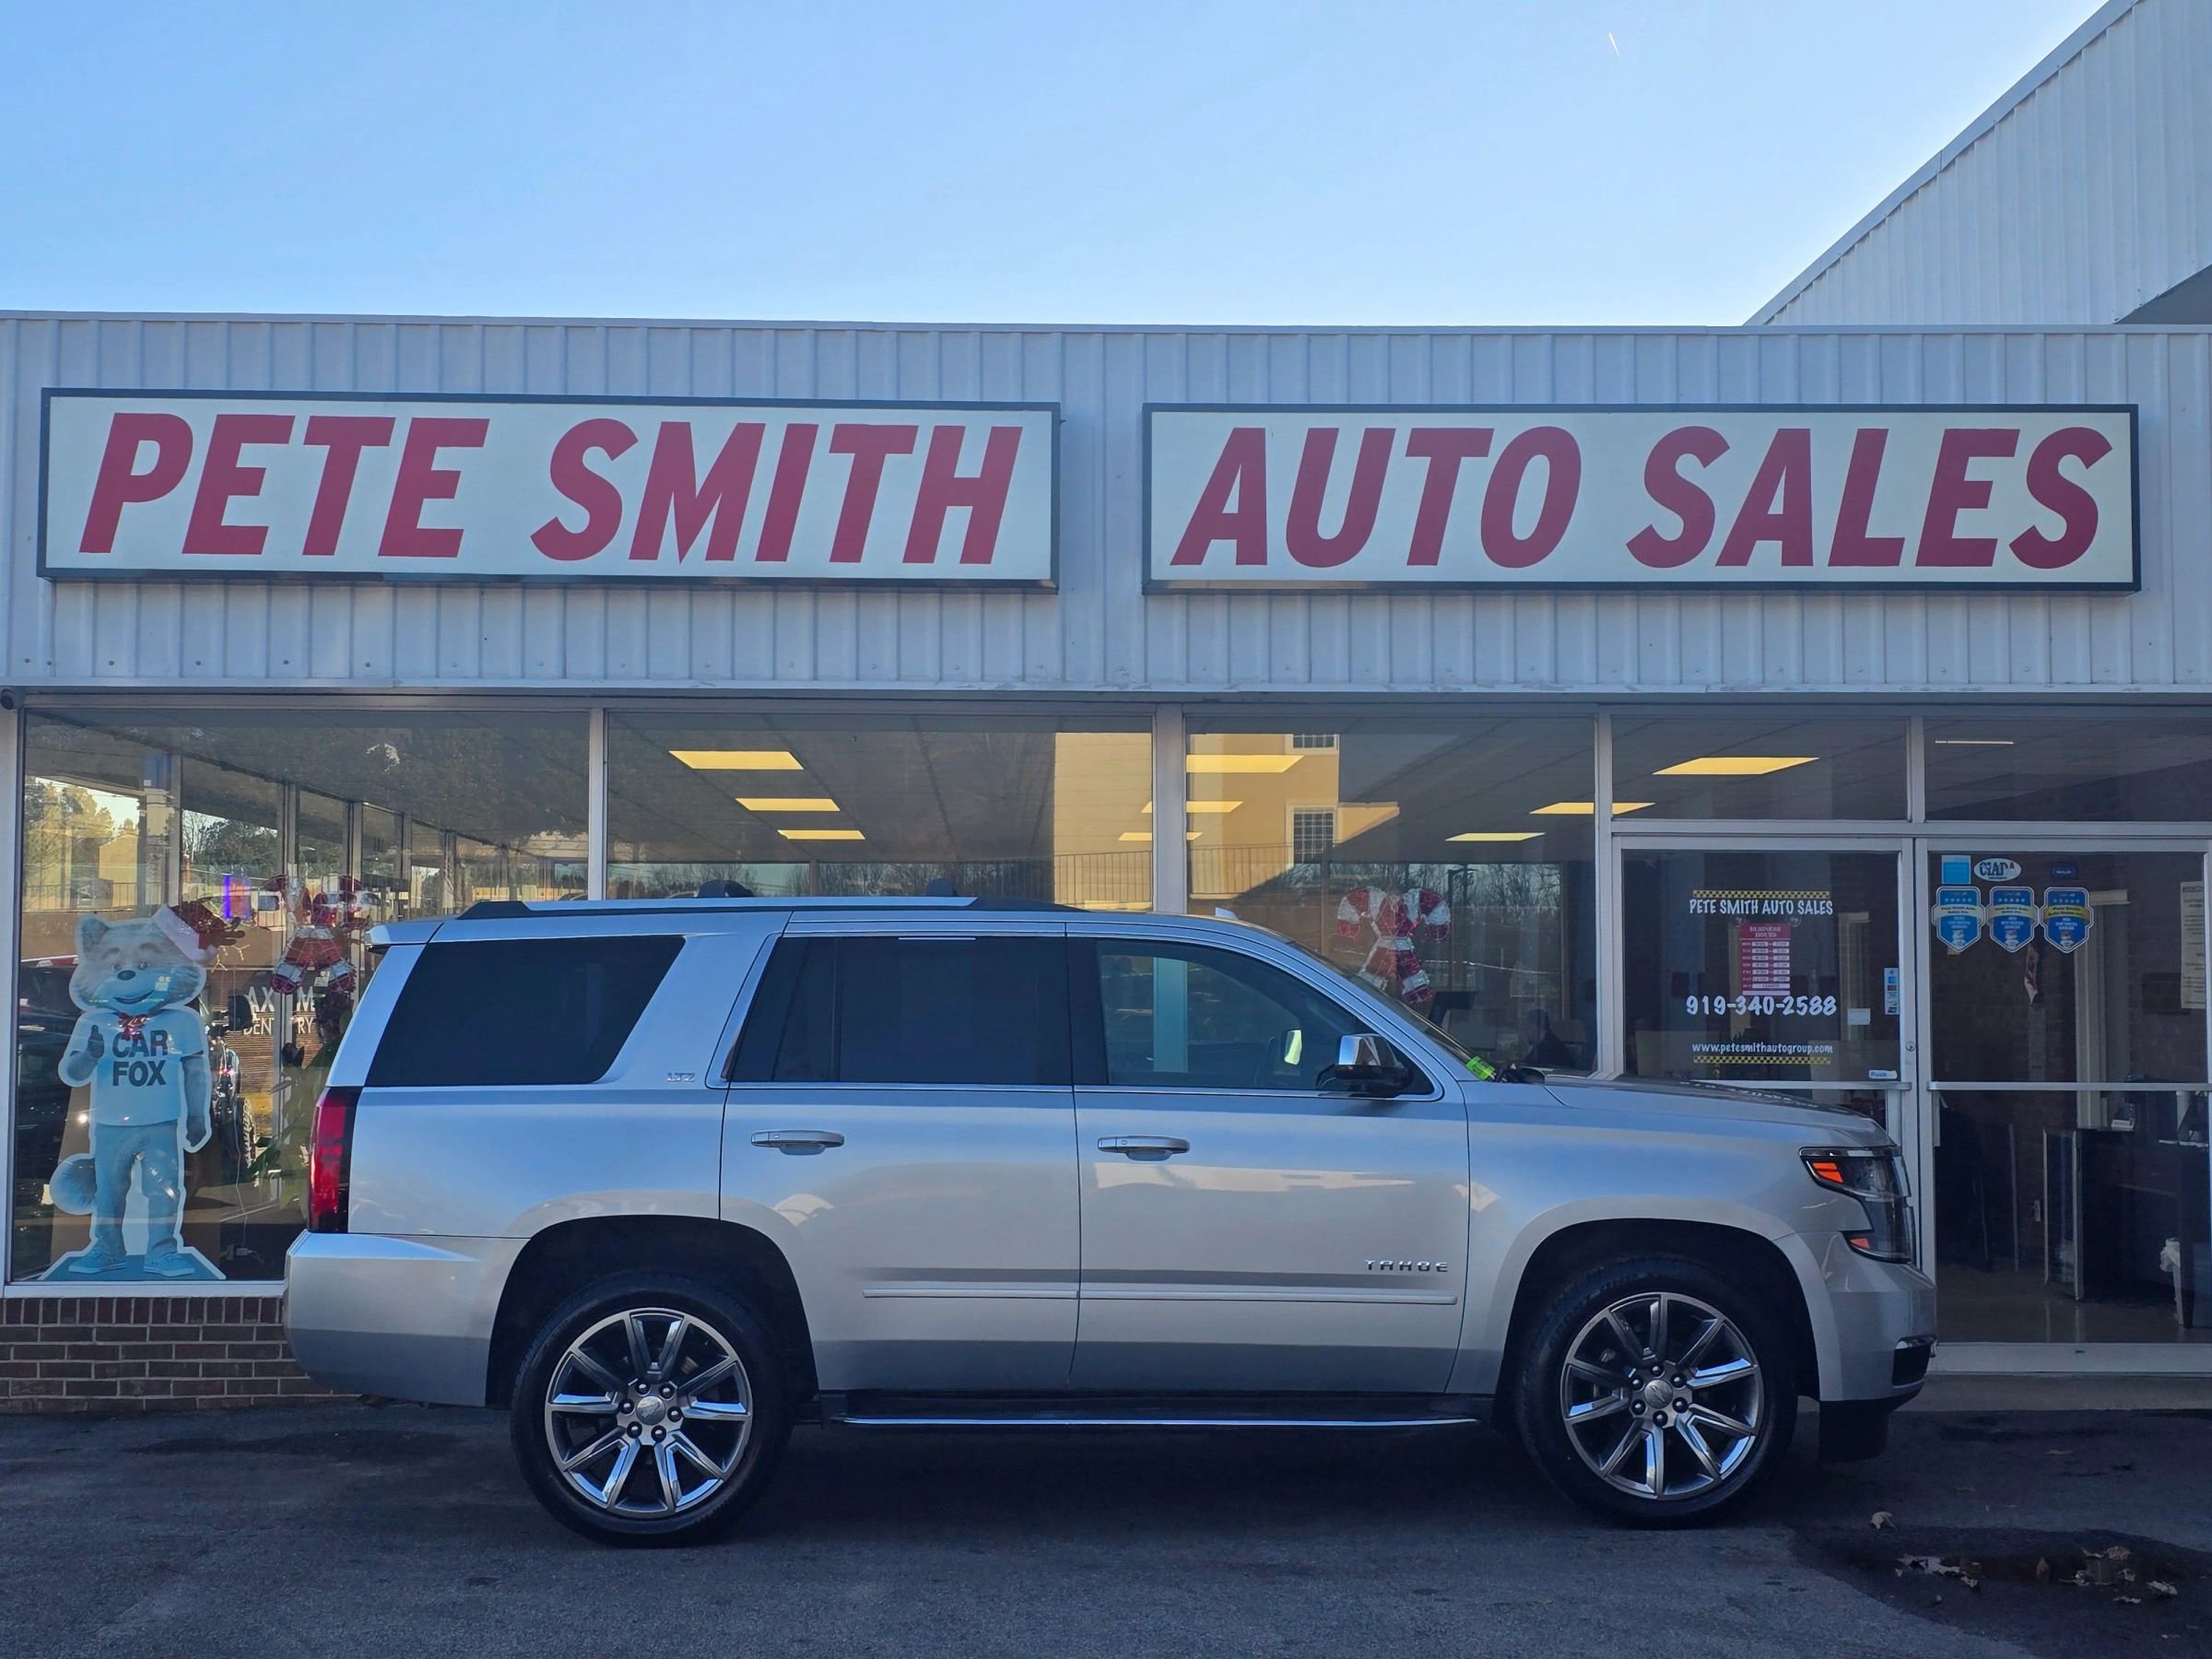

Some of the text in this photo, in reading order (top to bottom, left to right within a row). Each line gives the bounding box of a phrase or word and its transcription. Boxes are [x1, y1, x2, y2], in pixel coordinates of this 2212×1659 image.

[78, 413, 1023, 565] PETE SMITH
[1170, 425, 2112, 569] AUTO SALES
[1689, 898, 1833, 915] PETE SMITH AUTO SALES
[1686, 995, 1837, 1016] 919-340-2588
[112, 1030, 169, 1058] CAR
[1691, 1041, 1833, 1055] www.petesmithautogroup.com
[112, 1060, 167, 1087] FOX
[666, 1072, 695, 1083] LTZ
[1364, 1259, 1449, 1273] TAHOE
